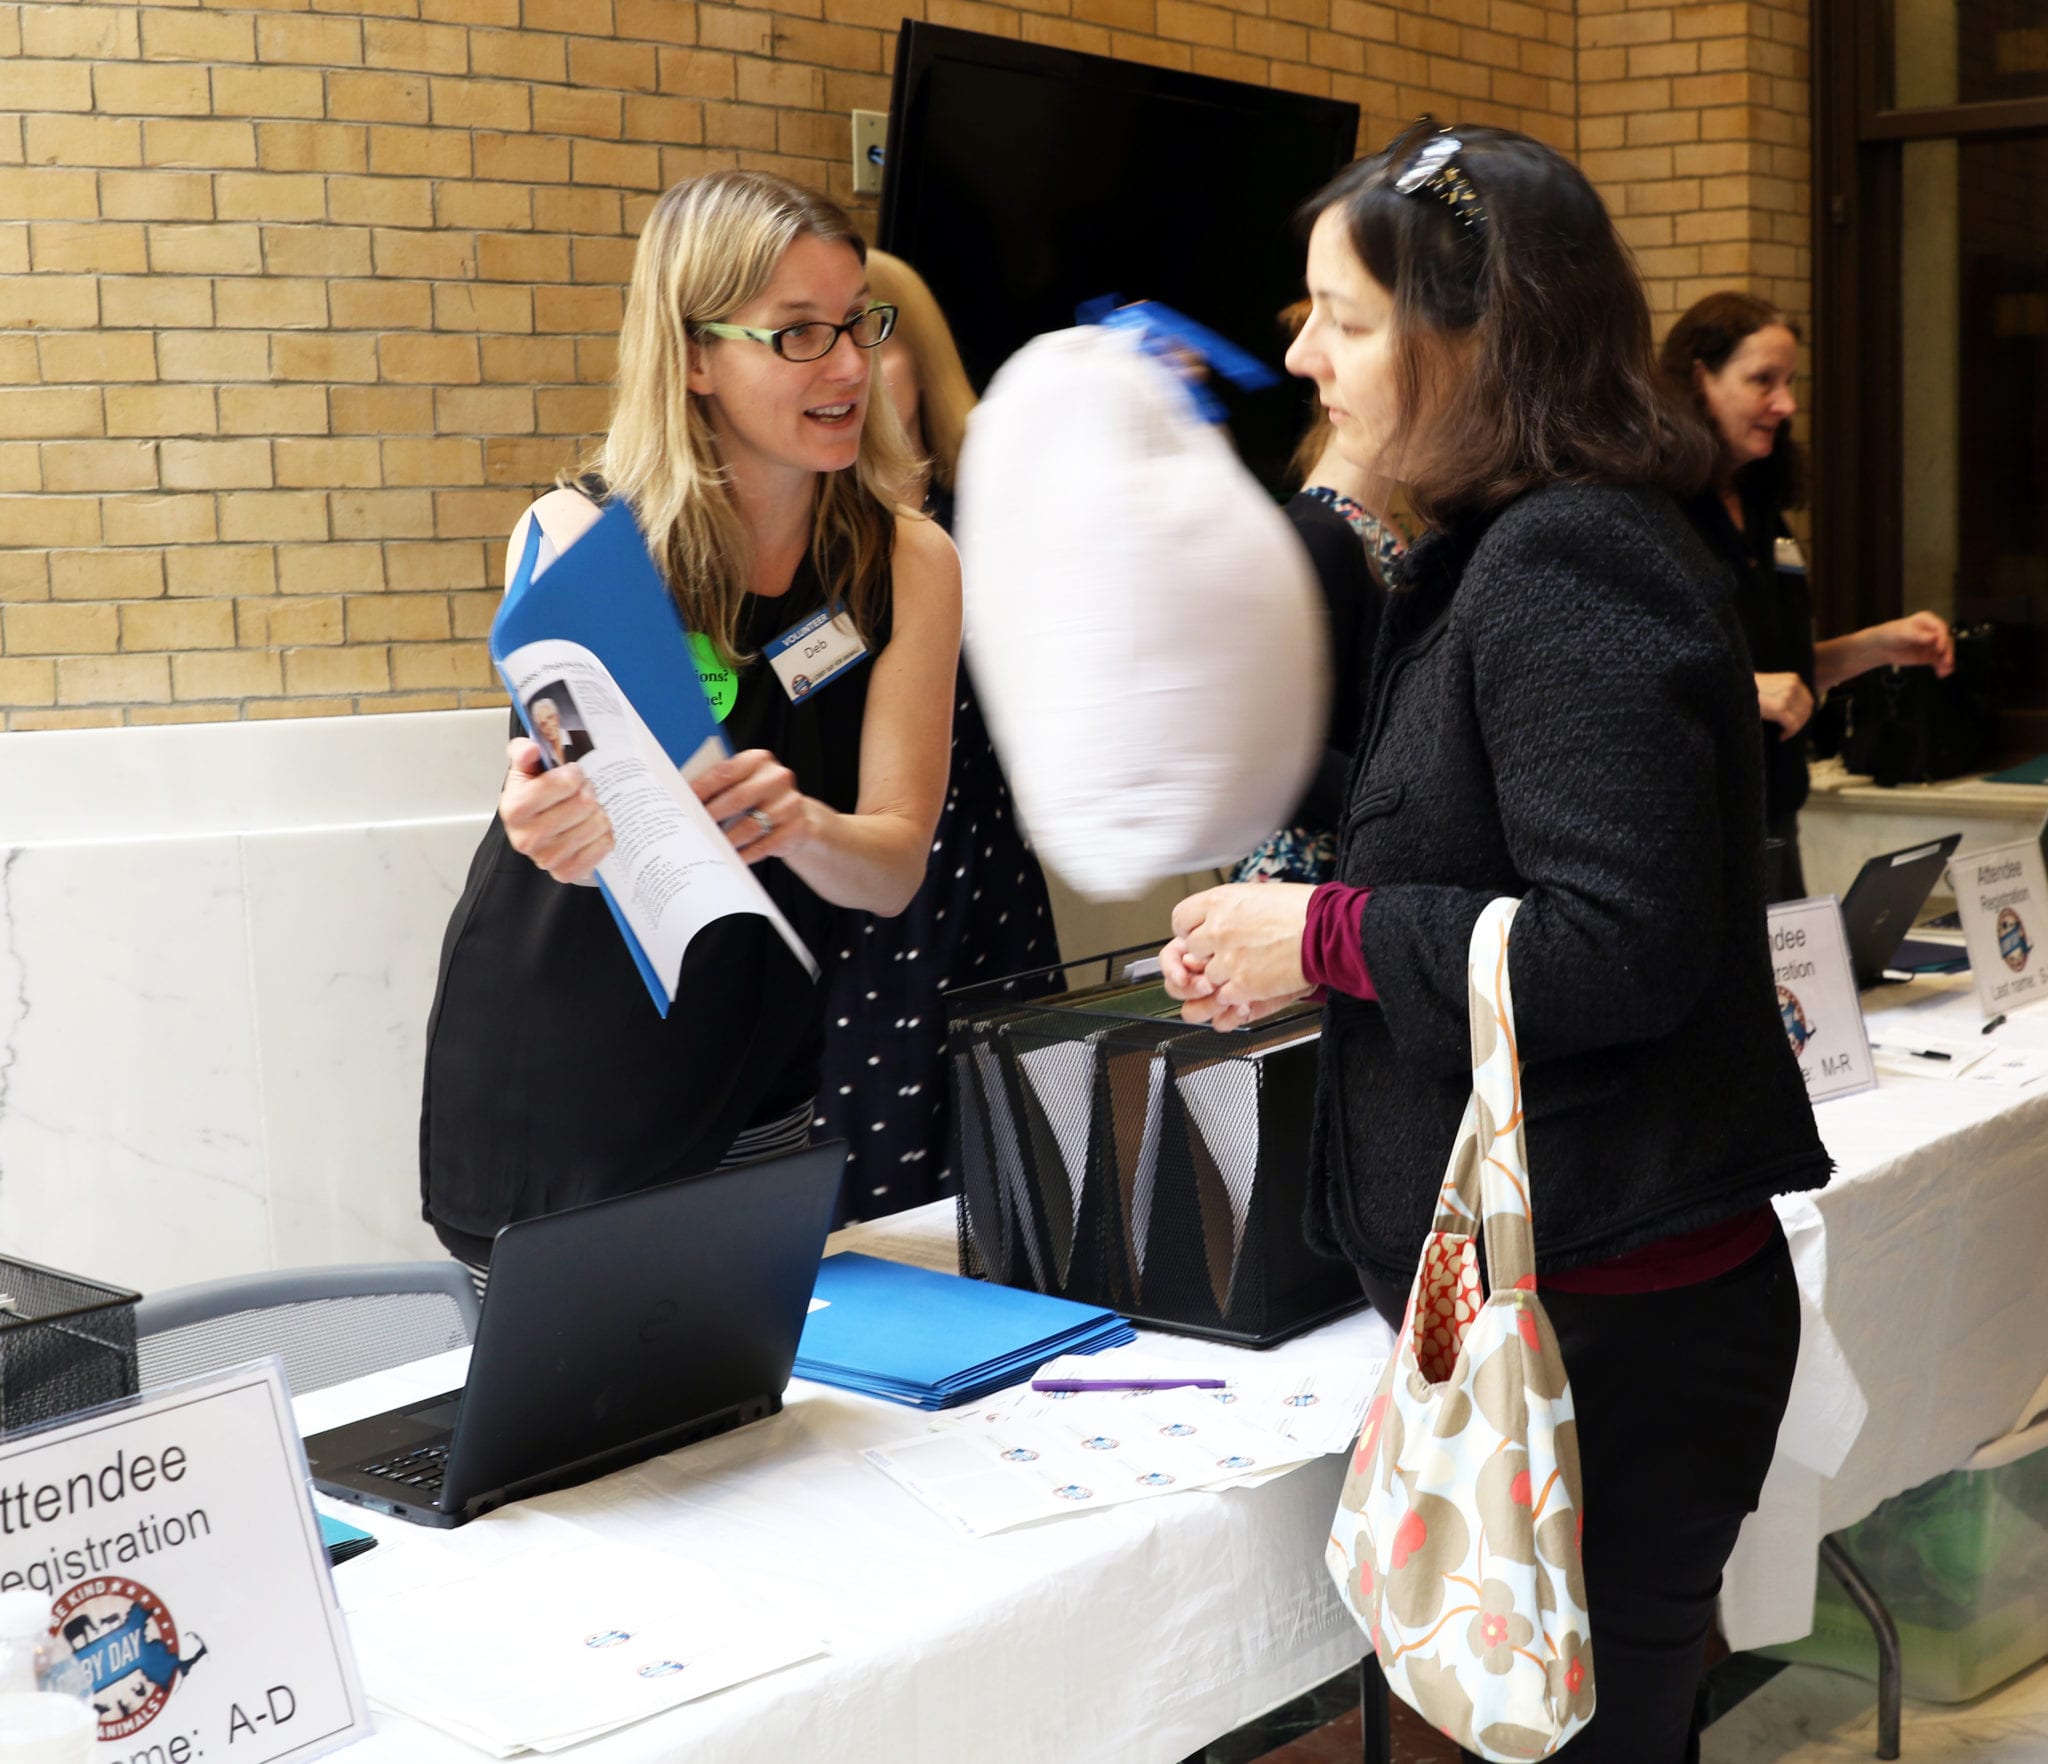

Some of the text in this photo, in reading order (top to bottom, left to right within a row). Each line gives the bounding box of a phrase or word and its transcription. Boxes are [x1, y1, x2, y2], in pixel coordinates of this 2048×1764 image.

[782, 614, 829, 647] VOLUNTEER
[804, 640, 828, 659] Deb
[1821, 1053, 1853, 1077] M-R
[0, 1446, 187, 1535] ttendee
[66, 1580, 107, 1607] KIND
[110, 1628, 141, 1673] DAY
[112, 1684, 297, 1764] me: A-D
